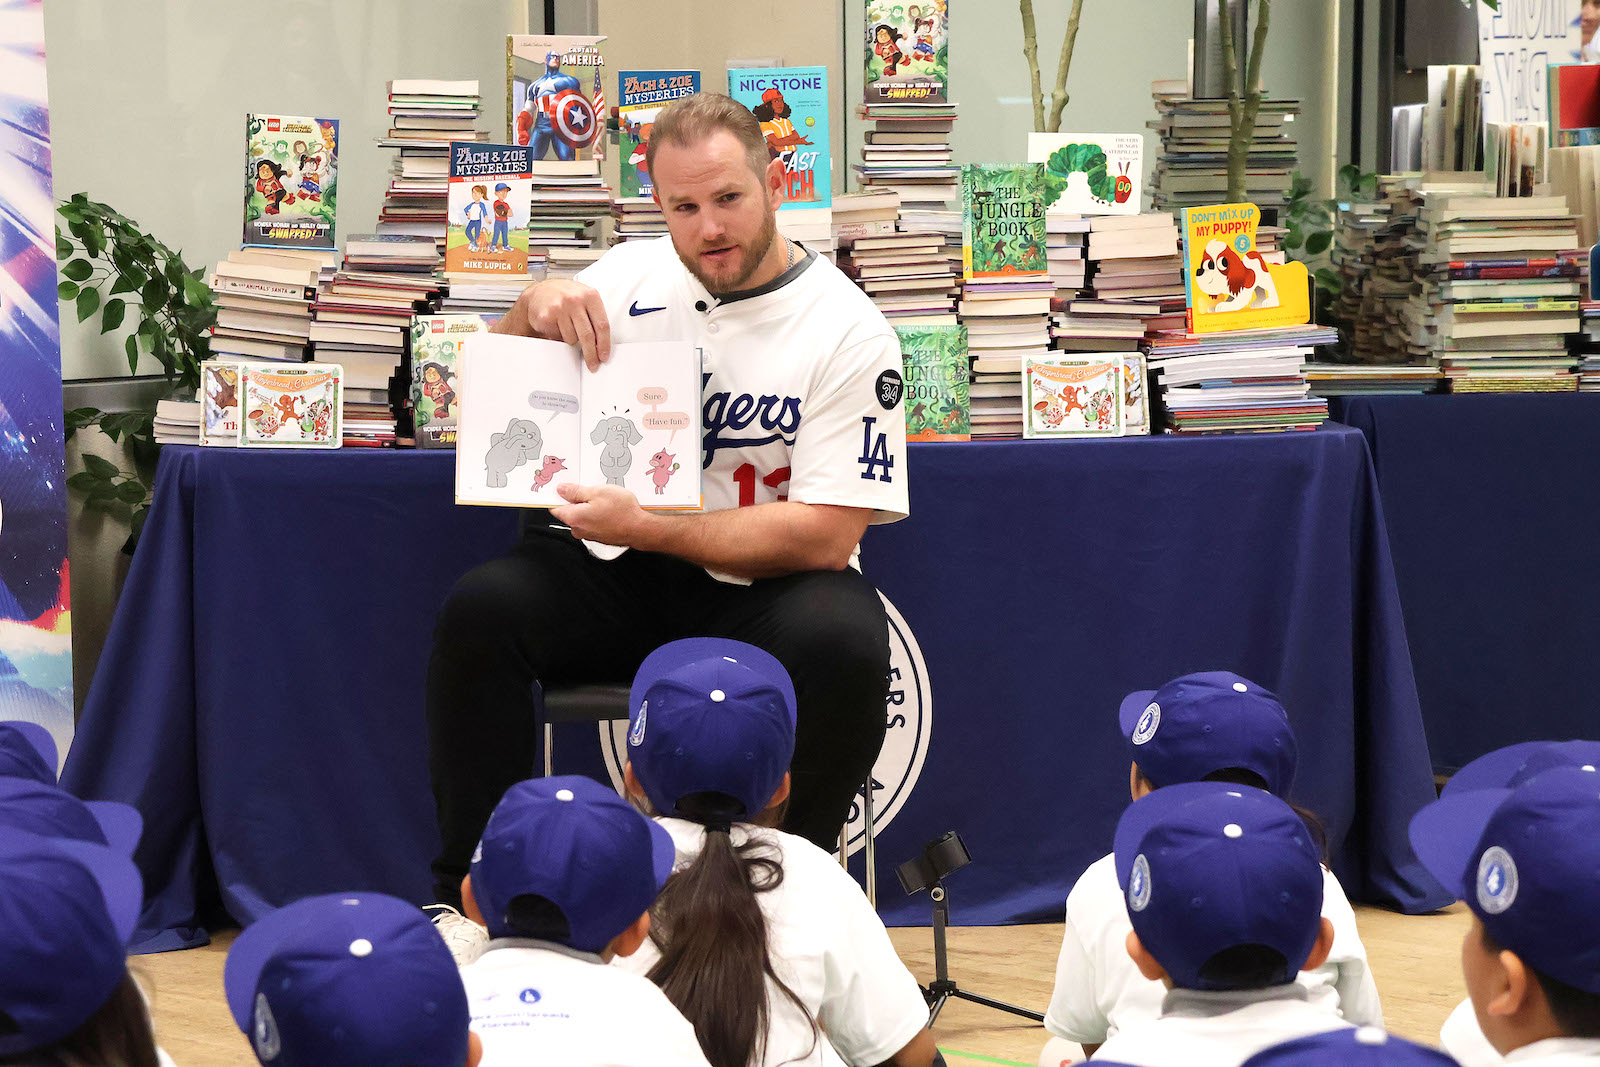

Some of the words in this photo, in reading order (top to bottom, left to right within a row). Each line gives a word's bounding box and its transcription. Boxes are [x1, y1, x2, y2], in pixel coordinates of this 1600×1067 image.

[562, 55, 605, 66] AMERICA
[624, 76, 638, 86] THE
[624, 80, 657, 94] ZACH
[658, 78, 668, 89] &
[669, 75, 693, 88] ZOE
[740, 79, 766, 92] NIC
[771, 77, 822, 91] STONE
[625, 86, 694, 104] MYSTERIES
[887, 88, 931, 99] SWAPPED!
[456, 151, 489, 164] ZACH
[491, 151, 501, 163] &
[502, 150, 527, 162] ZOE
[780, 151, 821, 173] FAST
[456, 161, 528, 175] MYSTERIES
[638, 187, 652, 195] MIK
[996, 187, 1021, 199] THE
[974, 202, 1042, 220] JUNGLE
[1192, 213, 1216, 223] DON'T
[1240, 209, 1254, 219] UP
[268, 228, 318, 240] SWAPPED!
[988, 222, 1029, 237] BOOK
[1196, 226, 1210, 236] MY
[1213, 221, 1252, 235] PUPPY!
[1240, 239, 1246, 248] 5
[463, 261, 483, 269] MIKE
[484, 261, 512, 270] LUPICA
[916, 350, 942, 362] THE
[904, 366, 964, 382] UNGLE
[1076, 365, 1109, 379] Christmas
[294, 375, 328, 388] Christmas
[643, 393, 664, 401] Sure.
[881, 383, 898, 404] 34
[906, 384, 950, 400] BOOK
[703, 373, 802, 449] gers
[223, 422, 238, 430] Th
[858, 416, 894, 483] LA
